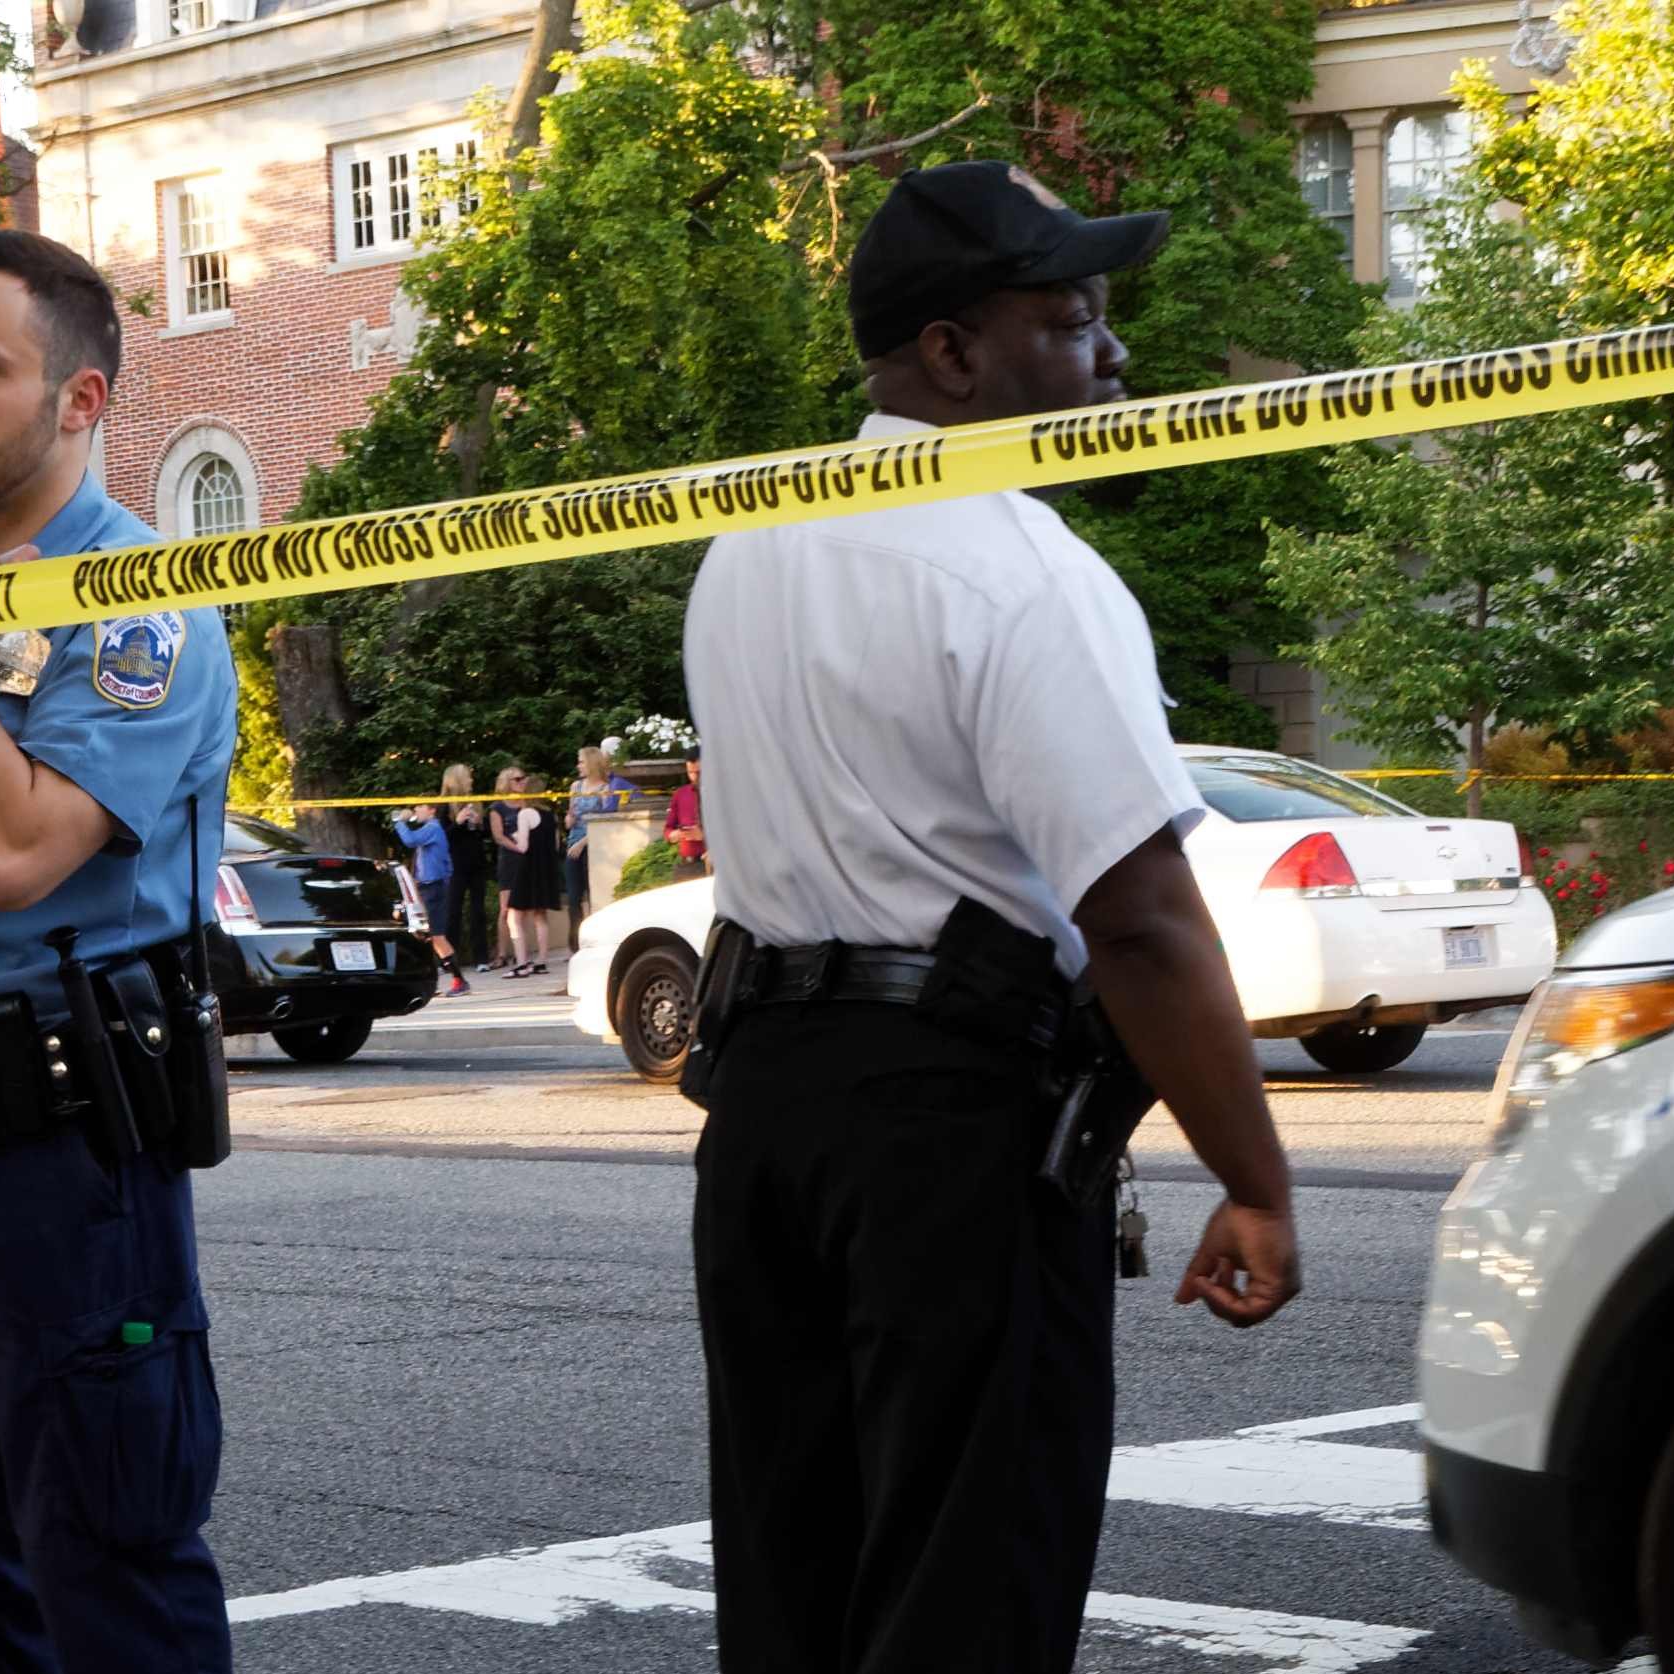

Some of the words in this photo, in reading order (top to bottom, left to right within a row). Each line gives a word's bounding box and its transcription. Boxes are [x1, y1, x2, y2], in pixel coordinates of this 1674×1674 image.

[1030, 408, 1157, 464] POLICE
[1165, 394, 1246, 444] LINE
[1256, 383, 1312, 430] DO
[1321, 371, 1398, 421] NOT
[73, 549, 166, 609] POLICE
[167, 539, 228, 596] LINE
[227, 533, 270, 587] DO
[272, 524, 334, 581] NOT
[334, 509, 437, 571] CROSS
[437, 491, 541, 556] CRIME
[541, 475, 678, 541] SOLVERS
